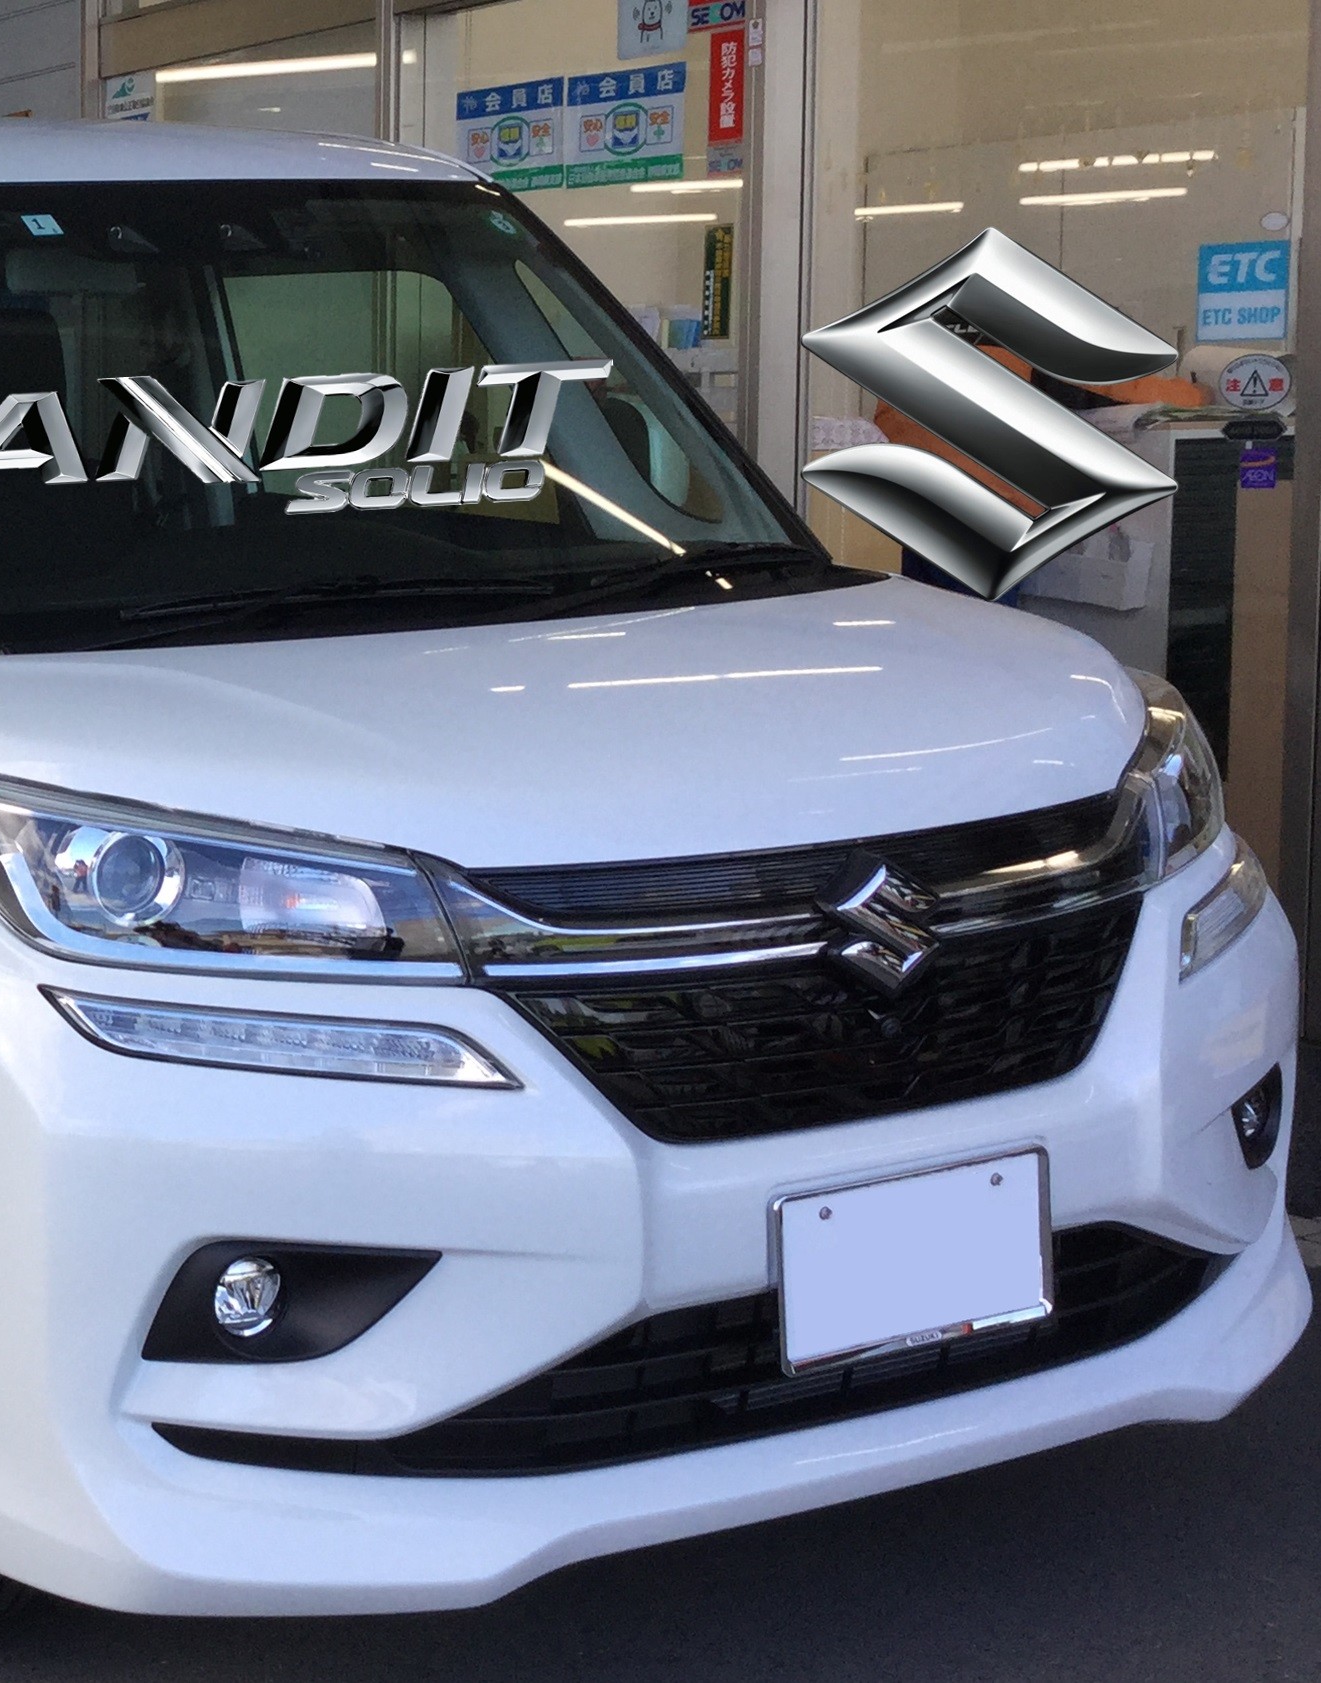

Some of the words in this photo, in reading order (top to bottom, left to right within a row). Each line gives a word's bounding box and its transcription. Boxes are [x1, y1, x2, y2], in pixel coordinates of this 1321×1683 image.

[691, 1, 746, 27] SECOM
[599, 69, 675, 98] 会員店
[720, 42, 738, 129] 防犯カメラ設置
[484, 84, 553, 113] 会員店
[1207, 250, 1282, 285] ETC
[1202, 308, 1232, 326] ETC
[1237, 306, 1281, 325] SHOP
